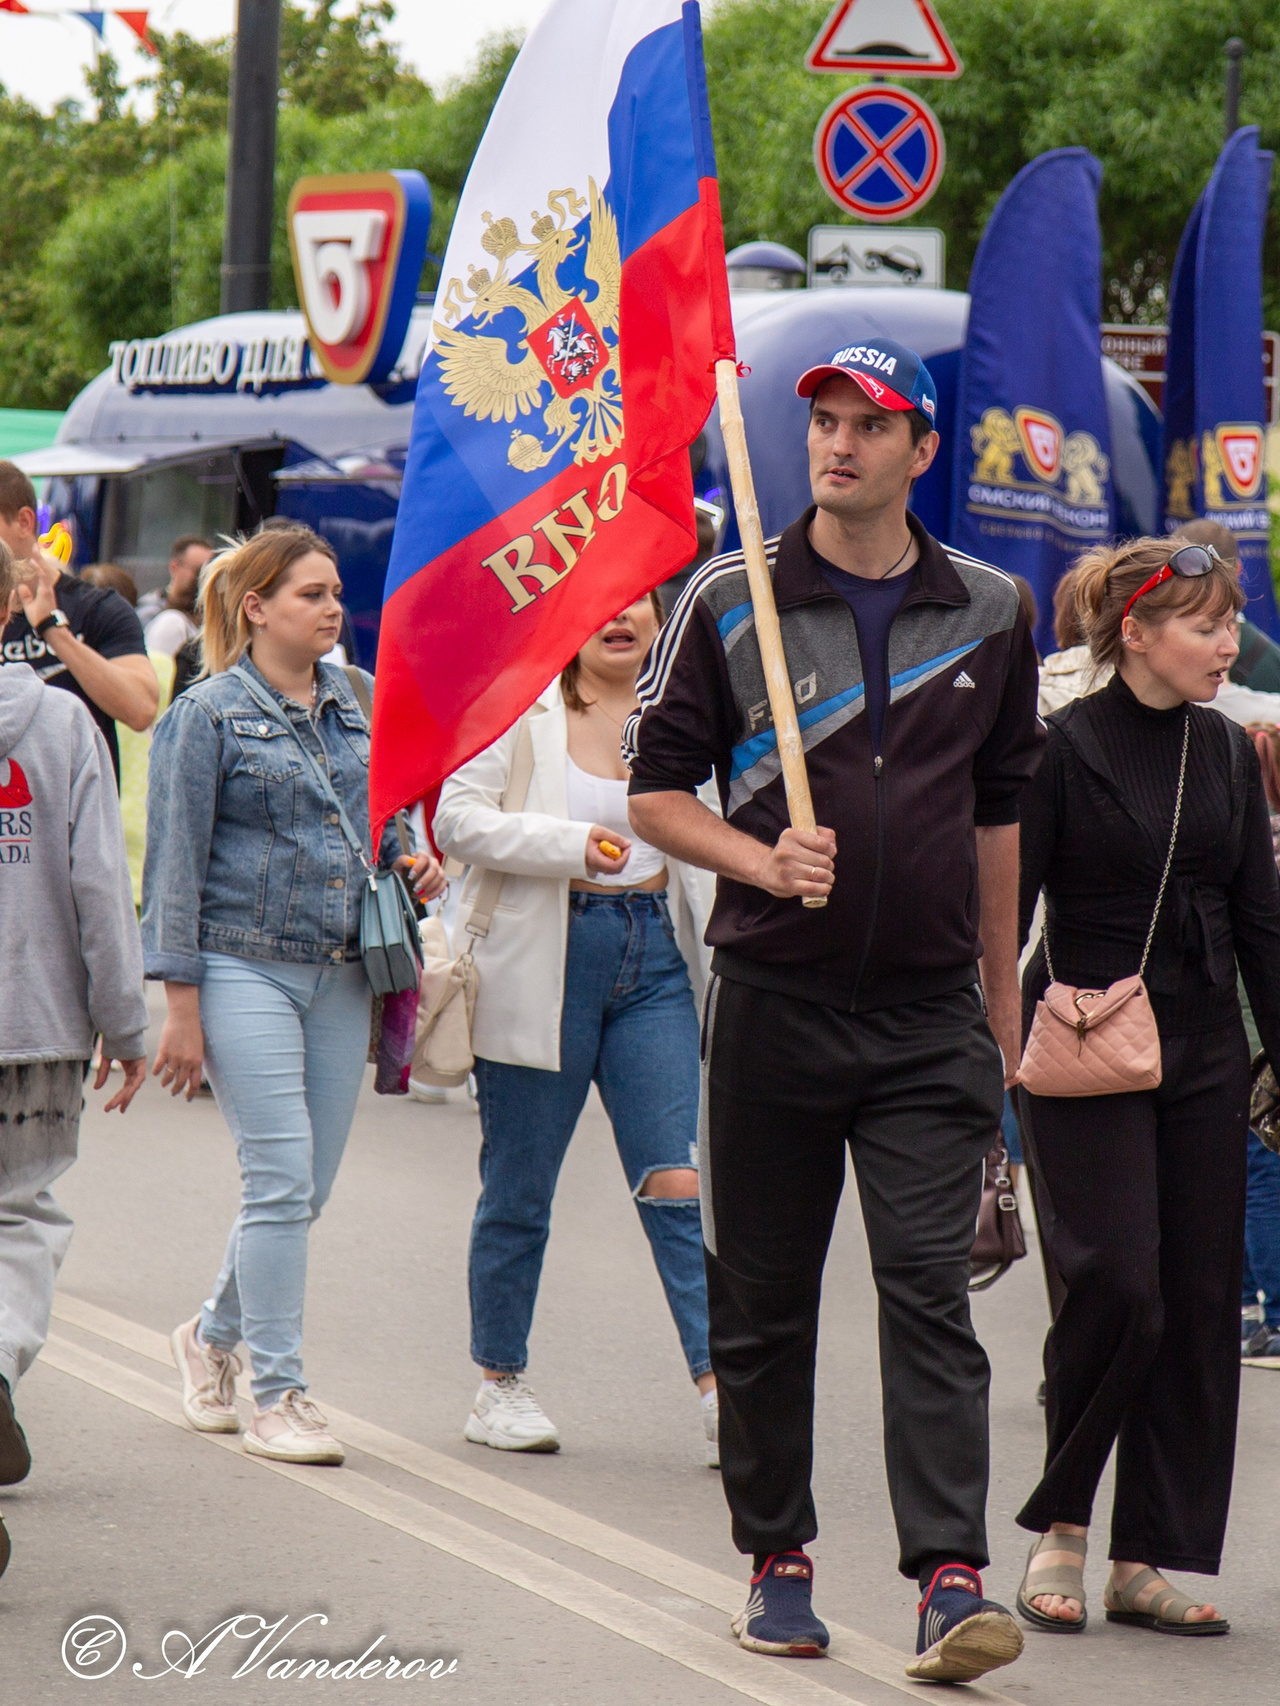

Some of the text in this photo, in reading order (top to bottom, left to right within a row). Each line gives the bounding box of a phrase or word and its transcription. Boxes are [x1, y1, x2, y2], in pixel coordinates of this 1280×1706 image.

[108, 339, 236, 385] ТОПЛИВО
[236, 336, 304, 392] ДЛЯ
[831, 346, 897, 376] RUSSIA
[968, 484, 1051, 511] ОМСКИЙ
[0, 811, 31, 836] RS
